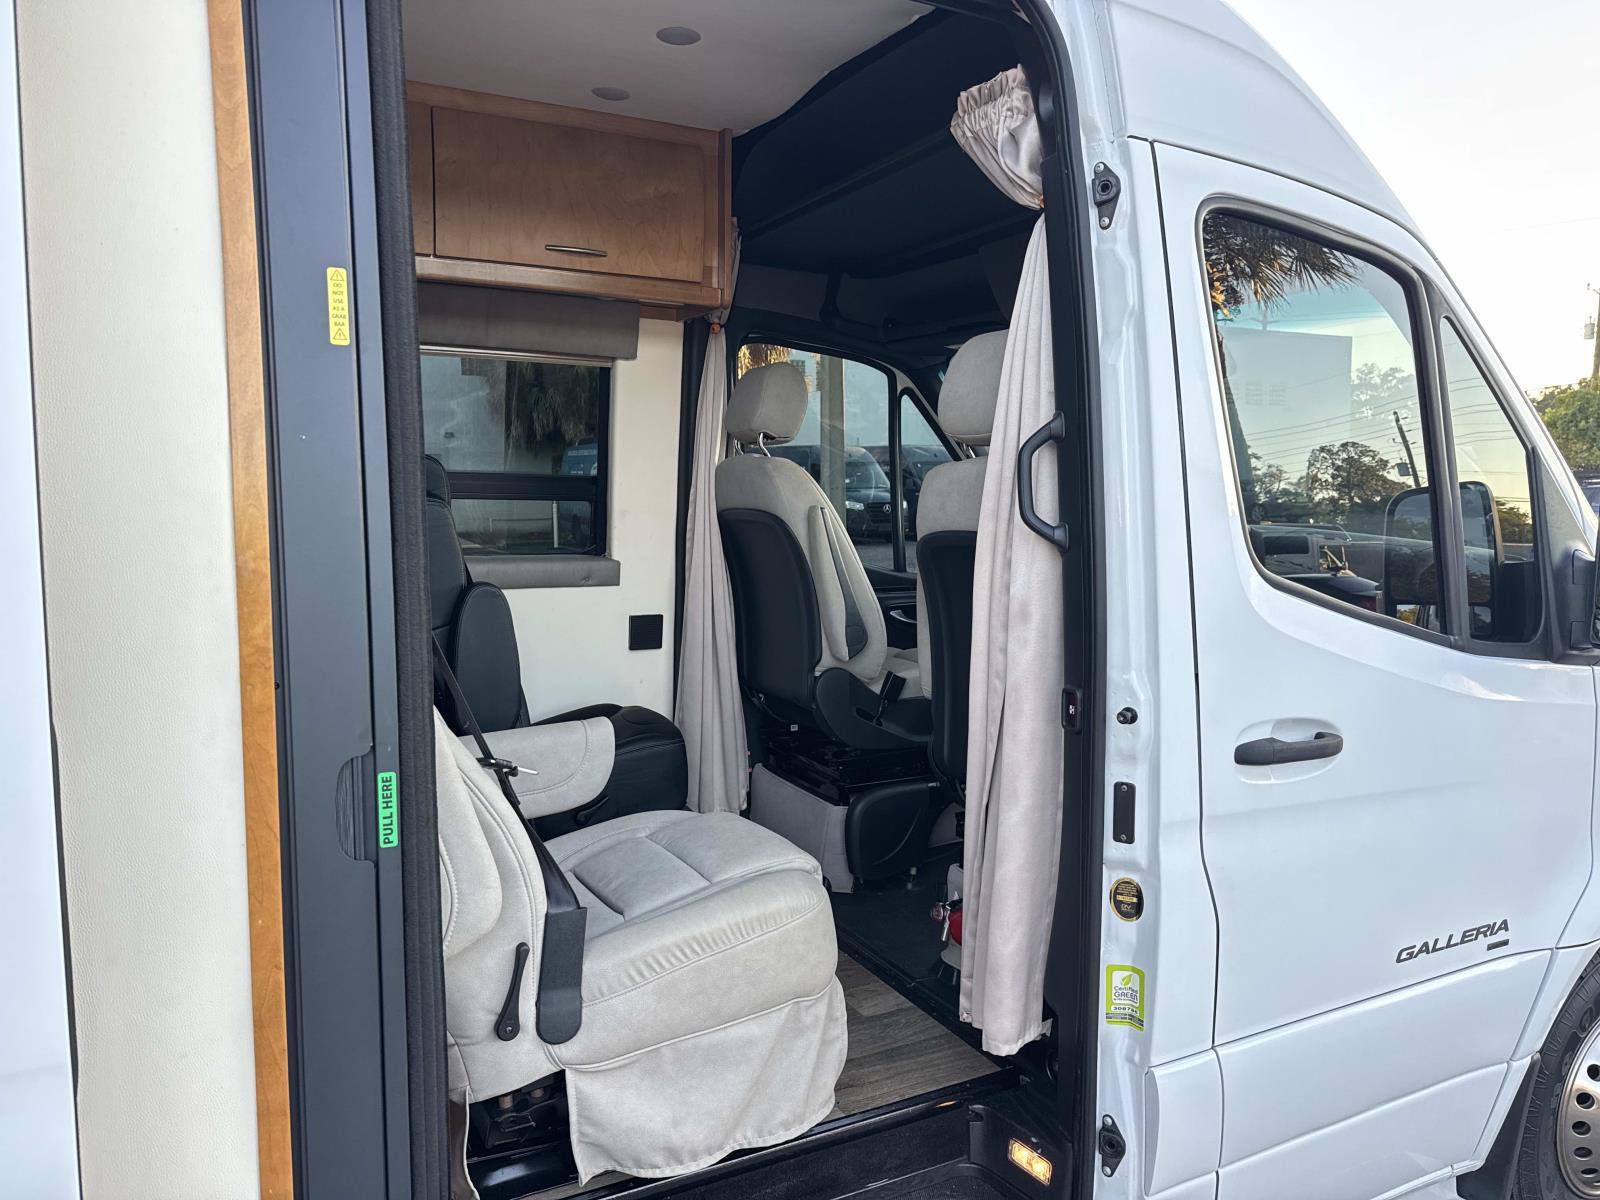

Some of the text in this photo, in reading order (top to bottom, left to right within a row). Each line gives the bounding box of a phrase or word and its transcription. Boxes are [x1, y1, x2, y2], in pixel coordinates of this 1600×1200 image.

[382, 776, 394, 845] PULL HERE
[1395, 918, 1510, 963] GALLERIA
[1113, 985, 1138, 994] Certified
[1113, 991, 1138, 1002] GREEN
